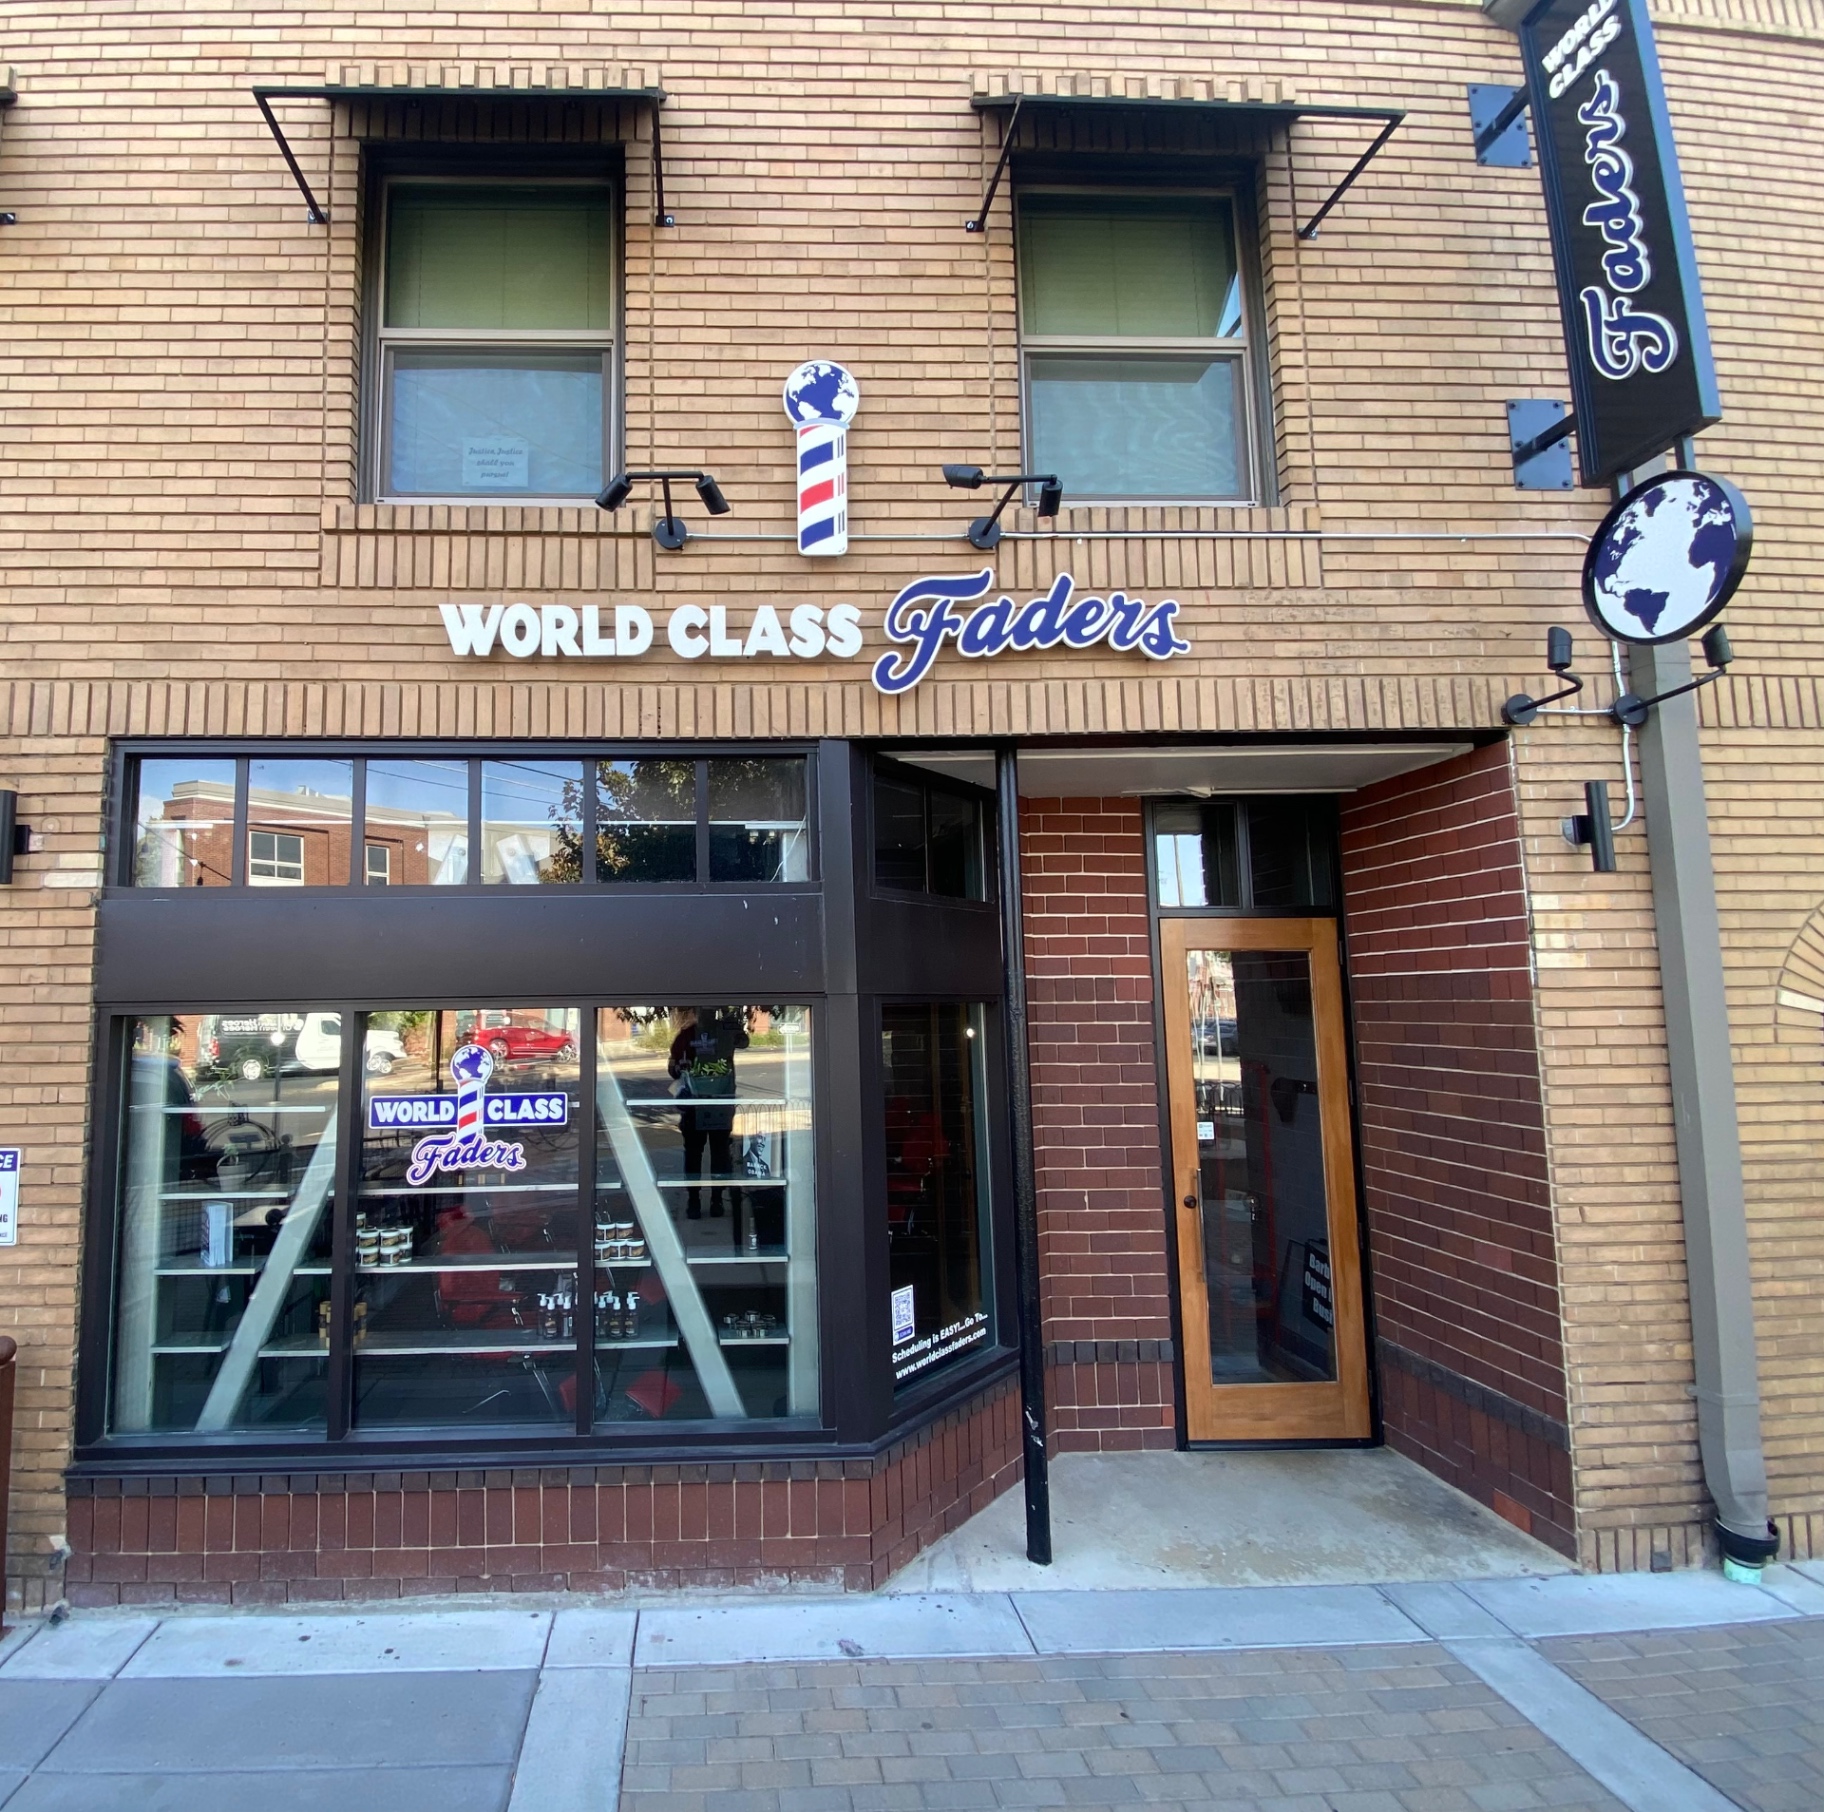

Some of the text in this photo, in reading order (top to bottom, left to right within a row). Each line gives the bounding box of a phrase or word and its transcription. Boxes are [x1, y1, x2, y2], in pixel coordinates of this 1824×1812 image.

[1549, 15, 1622, 98] CLASS
[1577, 69, 1678, 381] Faders
[476, 458, 515, 468] shall you
[497, 447, 523, 456] Justice
[438, 566, 1191, 695] WORLD CLASS Faders
[374, 1098, 563, 1123] WORLD CLASS
[406, 1131, 527, 1185] Faders
[1304, 1270, 1327, 1299] Open
[892, 1337, 932, 1363] Scheduling
[932, 1333, 940, 1344] is
[895, 1327, 987, 1380] www.worldclassfaders.com
